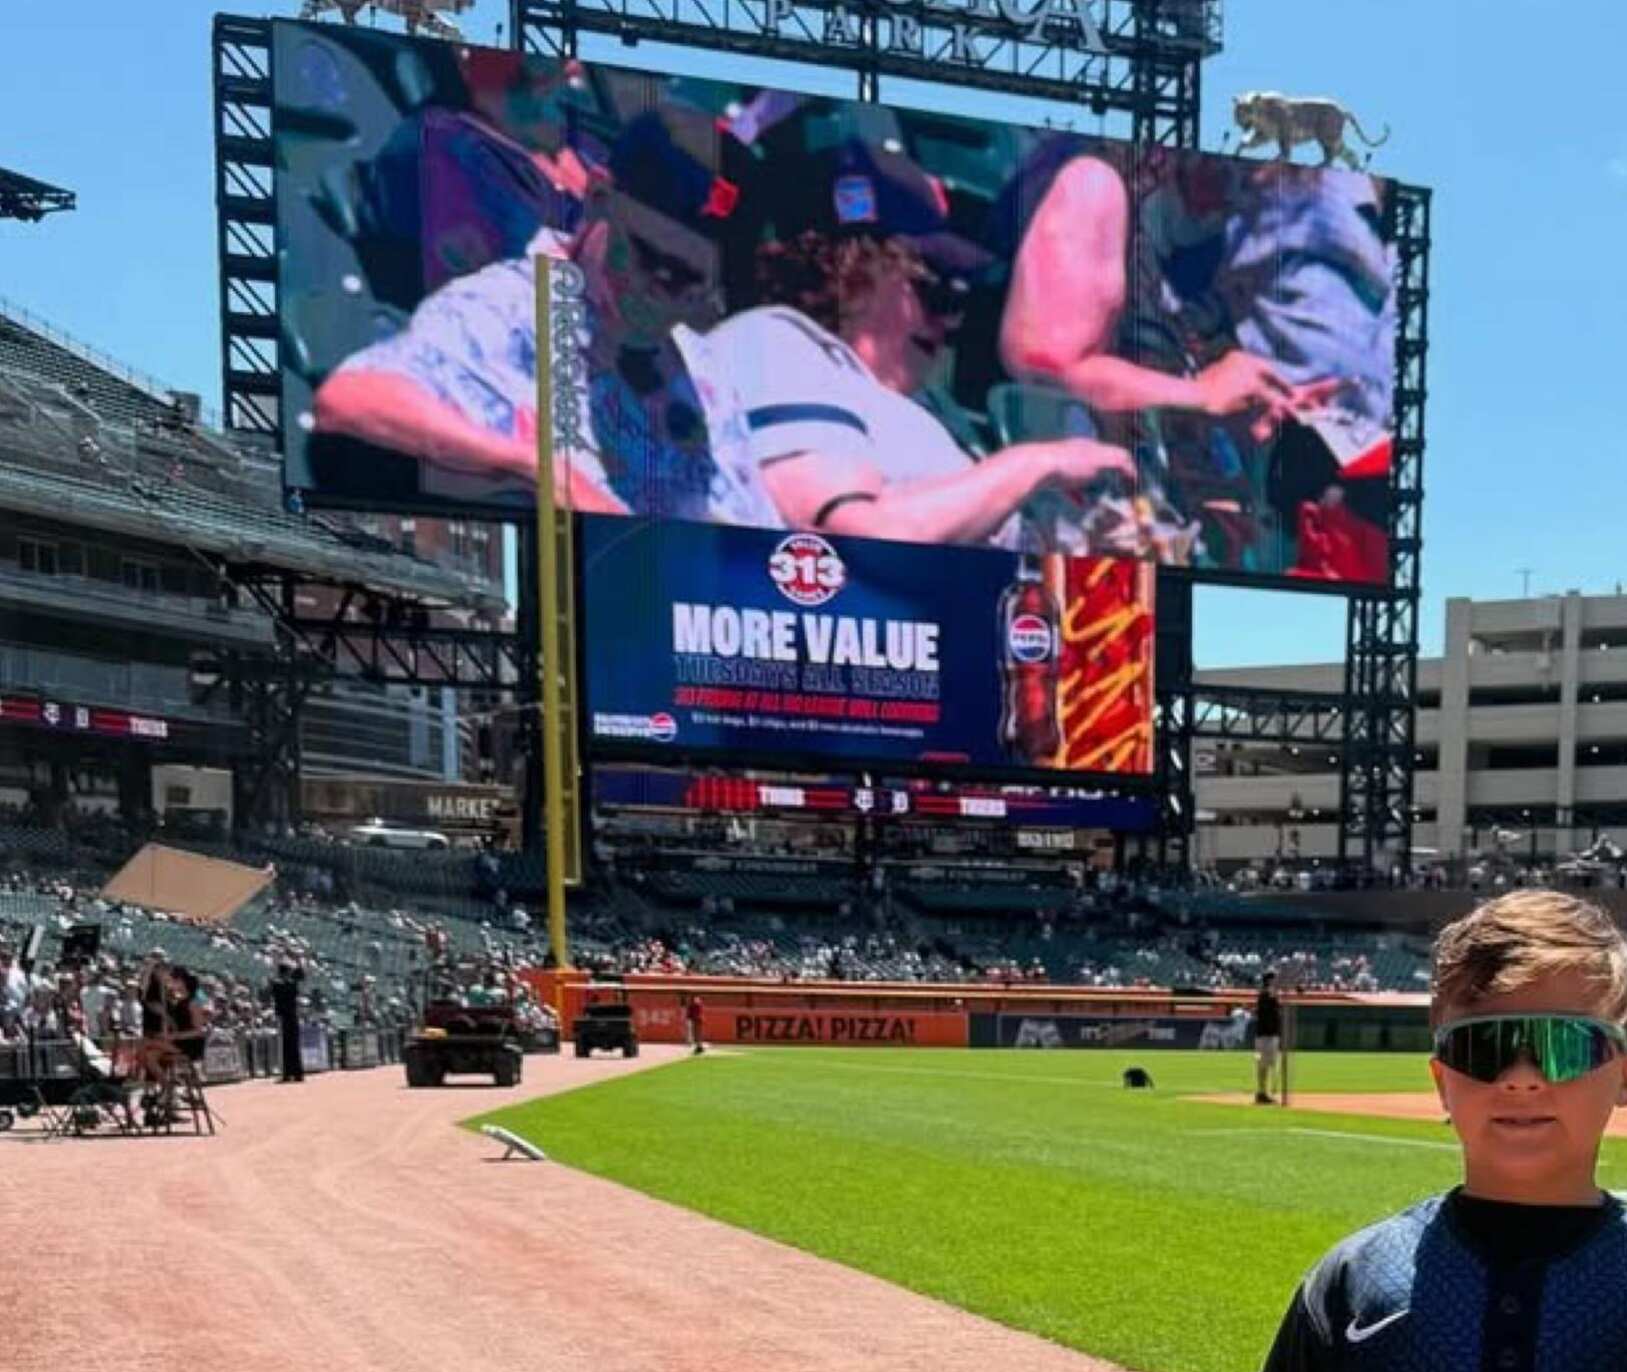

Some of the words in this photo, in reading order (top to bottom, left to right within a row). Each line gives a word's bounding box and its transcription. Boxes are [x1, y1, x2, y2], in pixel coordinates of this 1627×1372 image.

[768, 552, 846, 588] 313
[672, 602, 797, 661] MORE
[803, 614, 940, 672] VALUE
[735, 1016, 823, 1040] PIZZA!
[830, 1017, 915, 1040] PIZZA!
